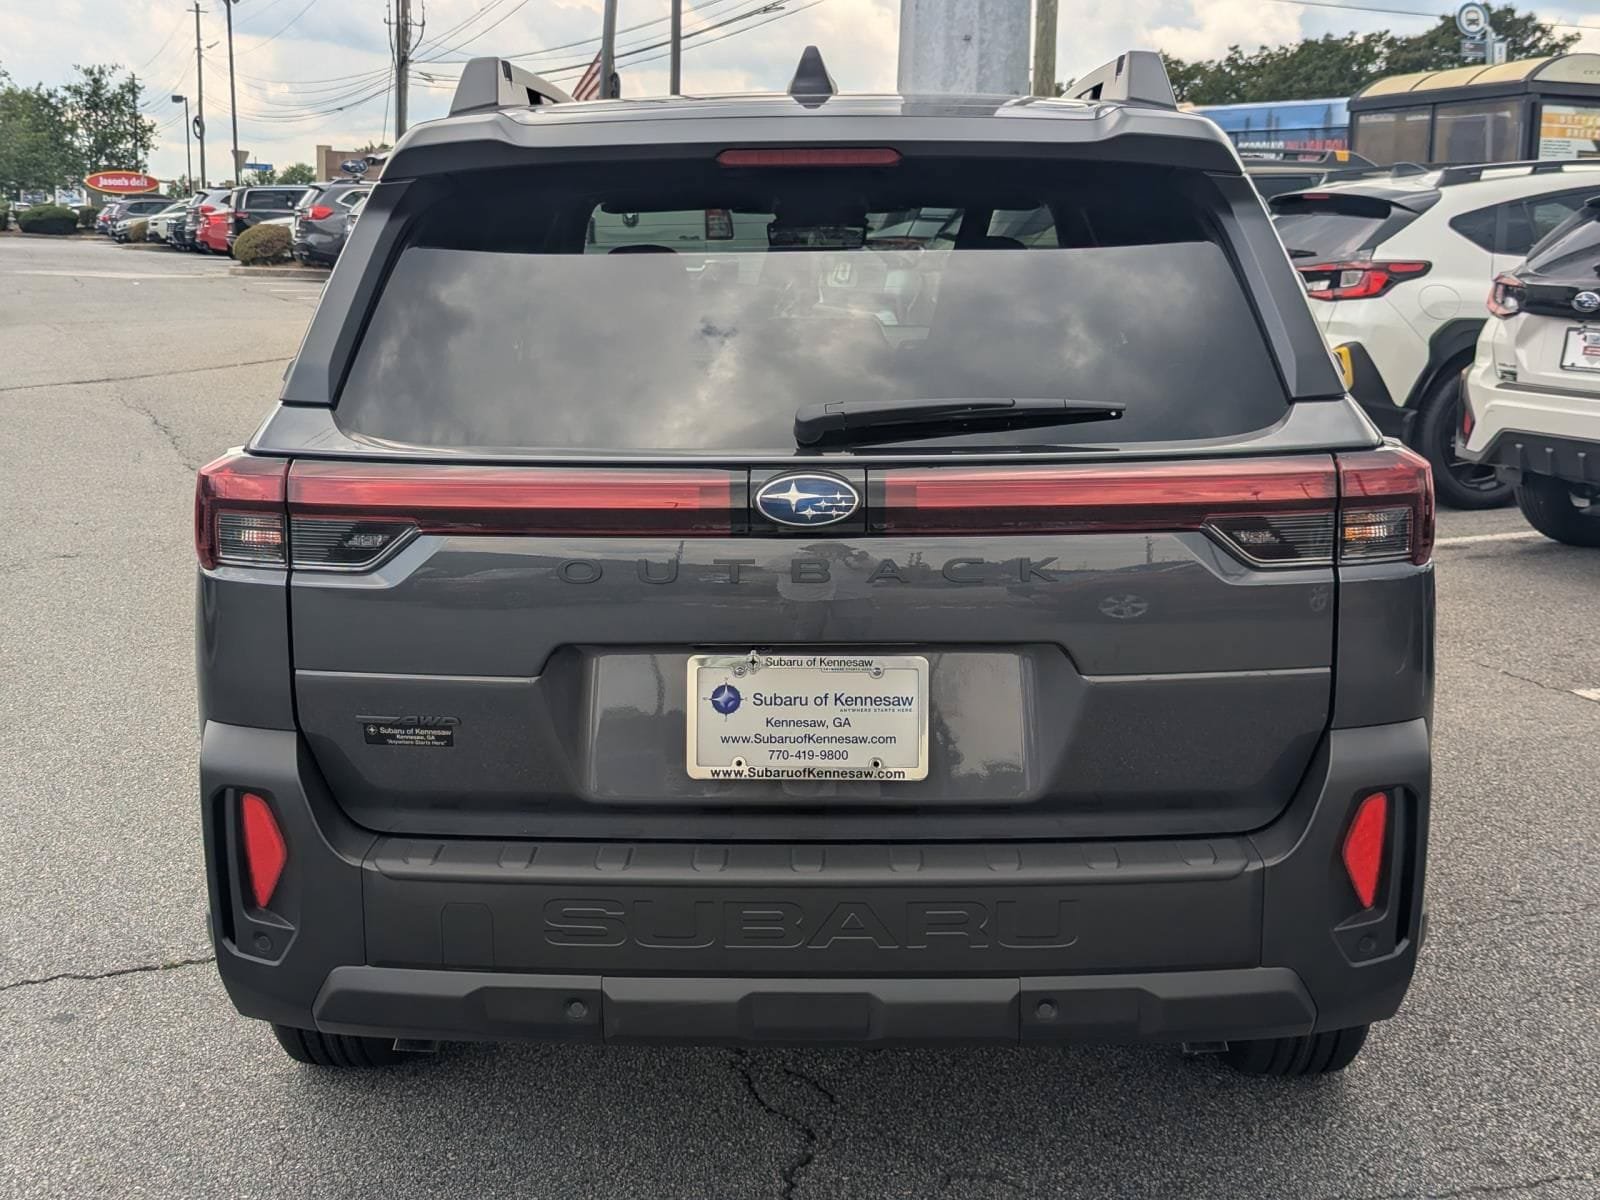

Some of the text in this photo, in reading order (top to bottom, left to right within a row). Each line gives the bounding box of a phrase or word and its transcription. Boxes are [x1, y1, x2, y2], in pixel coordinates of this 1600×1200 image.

[98, 175, 148, 188] Jason's deli
[555, 555, 1060, 585] OUTBACK
[765, 657, 874, 668] Subaru of Kennesaw
[752, 692, 914, 707] Subaru of Kennesaw
[765, 717, 852, 729] Kennesaw, GA
[379, 726, 452, 736] Subaru of Kennesaw
[720, 733, 897, 745] www.SubaruofKennesaw.com
[768, 750, 849, 761] 770-419-9800
[710, 767, 906, 779] www.SubaruofKennesaw.com
[543, 897, 1079, 950] SUBARU
